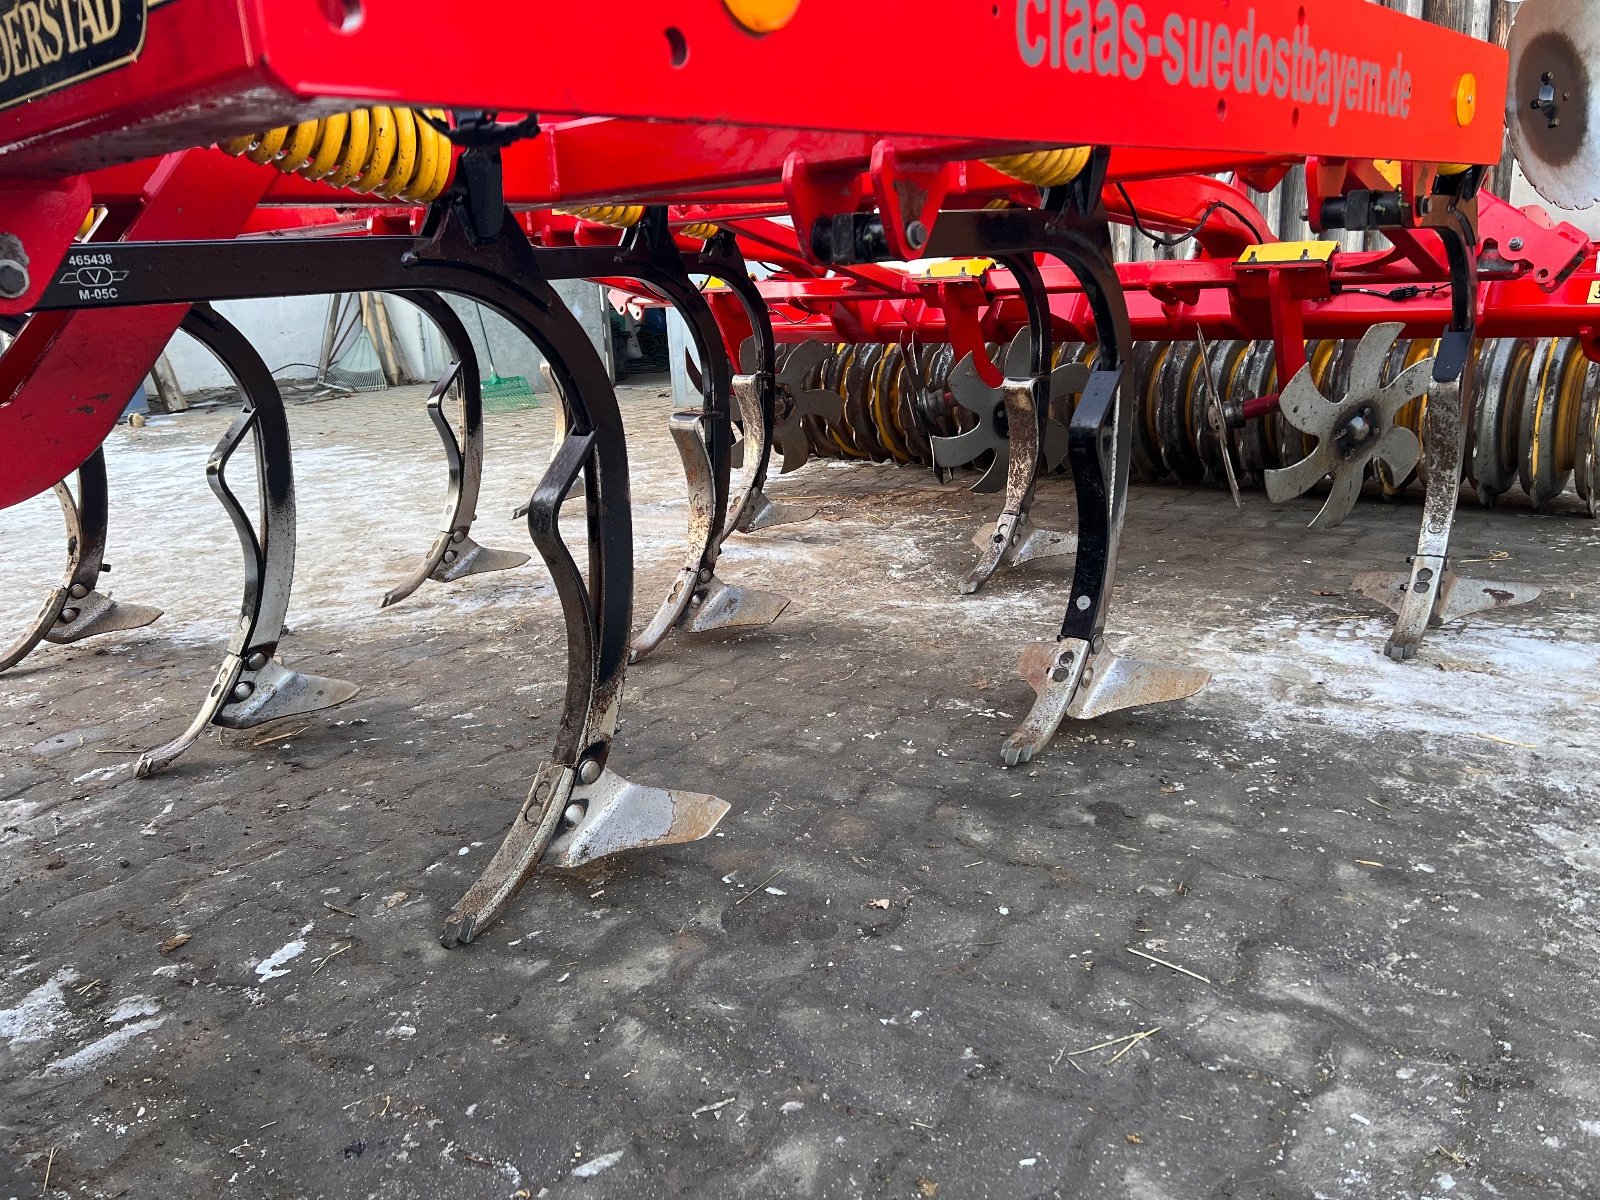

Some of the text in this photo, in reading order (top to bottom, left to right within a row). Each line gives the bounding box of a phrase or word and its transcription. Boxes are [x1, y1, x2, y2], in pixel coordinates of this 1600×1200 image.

[1015, 0, 1412, 127] claas-suedostbayern.de
[68, 254, 113, 266] 465438
[78, 288, 118, 300] M-05C
